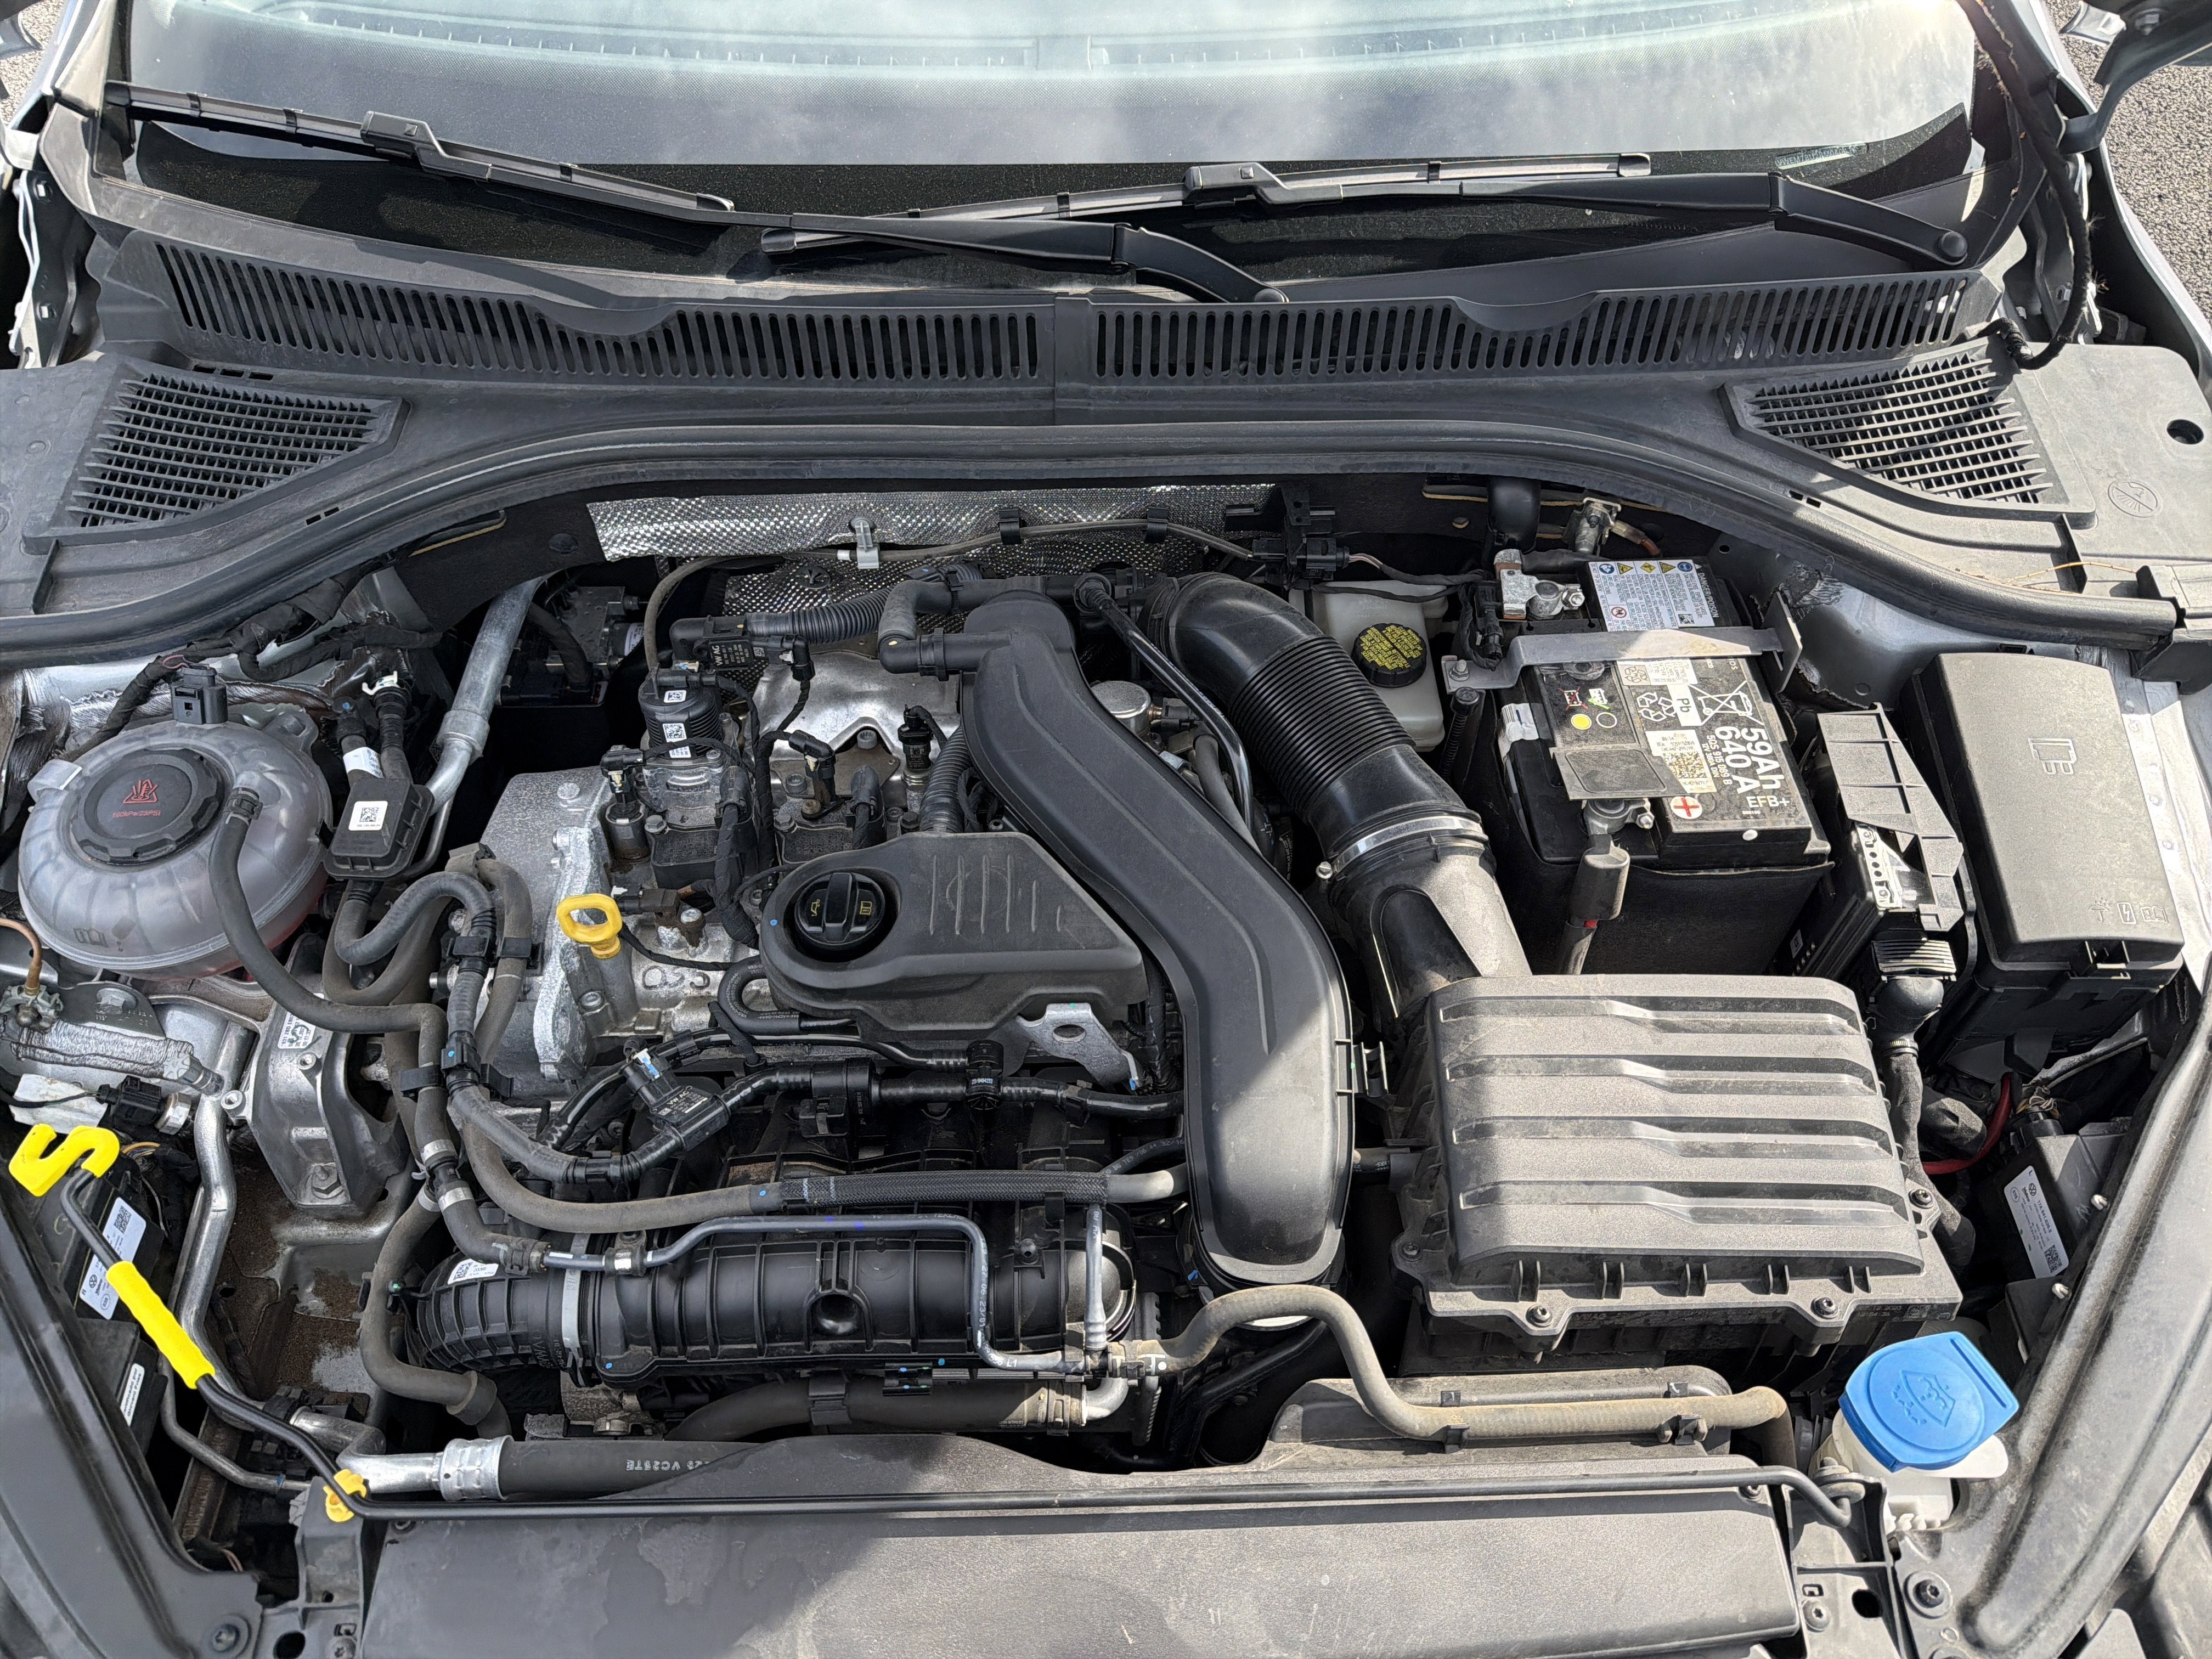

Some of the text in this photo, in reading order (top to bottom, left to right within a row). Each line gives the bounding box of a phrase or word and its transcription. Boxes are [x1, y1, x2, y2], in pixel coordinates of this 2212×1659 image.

[1697, 572, 1719, 617] DANGER/POISON
[712, 645, 723, 666] VW AG
[1677, 698, 1692, 713] Pb
[1715, 726, 1752, 768] 640
[1712, 751, 1724, 763] 915
[1740, 727, 1785, 790] 59Ah
[1731, 774, 1760, 794] A
[1746, 795, 1790, 808] EFB+
[667, 1097, 679, 1105] VW
[1122, 1155, 1134, 1165] TE9
[1092, 1210, 1099, 1238] VW AG
[626, 1459, 681, 1471] VC25TE
